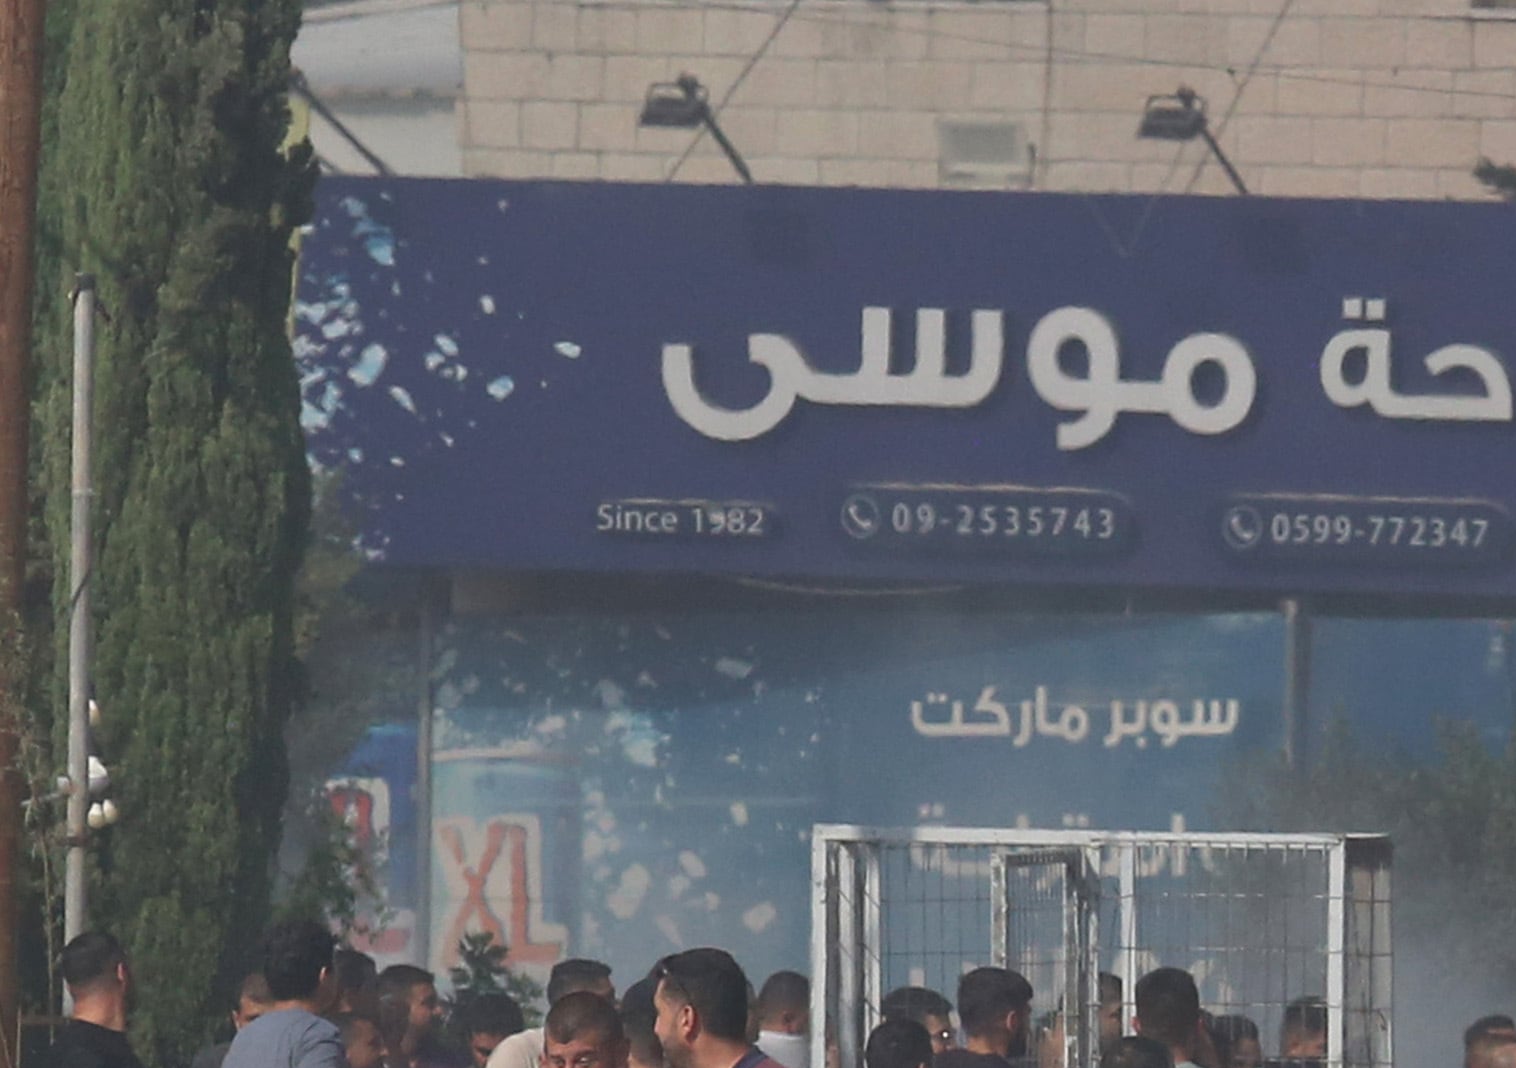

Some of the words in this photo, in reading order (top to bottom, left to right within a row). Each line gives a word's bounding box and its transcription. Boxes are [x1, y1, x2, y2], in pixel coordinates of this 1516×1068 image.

[660, 305, 1257, 452] موسى
[597, 503, 678, 533] Since
[692, 506, 764, 535] 1982
[892, 503, 1116, 540] 09-2535743
[1271, 513, 1490, 549] 0599-772347
[910, 684, 1090, 749] ماركت
[1103, 698, 1240, 749] سوبر
